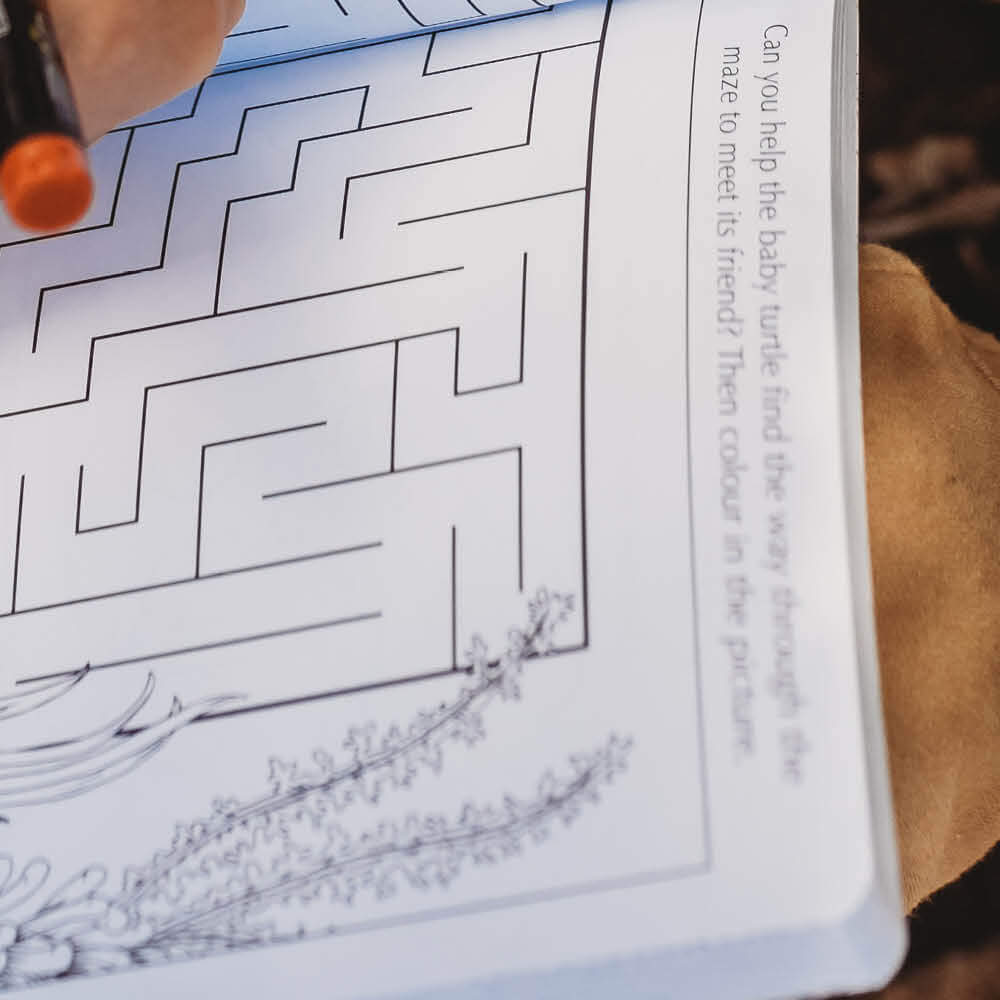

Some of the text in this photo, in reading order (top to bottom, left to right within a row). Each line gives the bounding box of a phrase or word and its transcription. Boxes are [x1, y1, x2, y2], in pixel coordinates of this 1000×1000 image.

[720, 47, 740, 103] maze
[719, 112, 740, 134] to
[717, 143, 740, 201] meet
[716, 211, 742, 238] its
[716, 247, 744, 337] friend?
[717, 349, 745, 416] Then
[751, 24, 813, 788] Can you help the baby turtle find the way through the
[719, 425, 750, 524] colour
[723, 533, 752, 565] in
[725, 574, 756, 627] the
